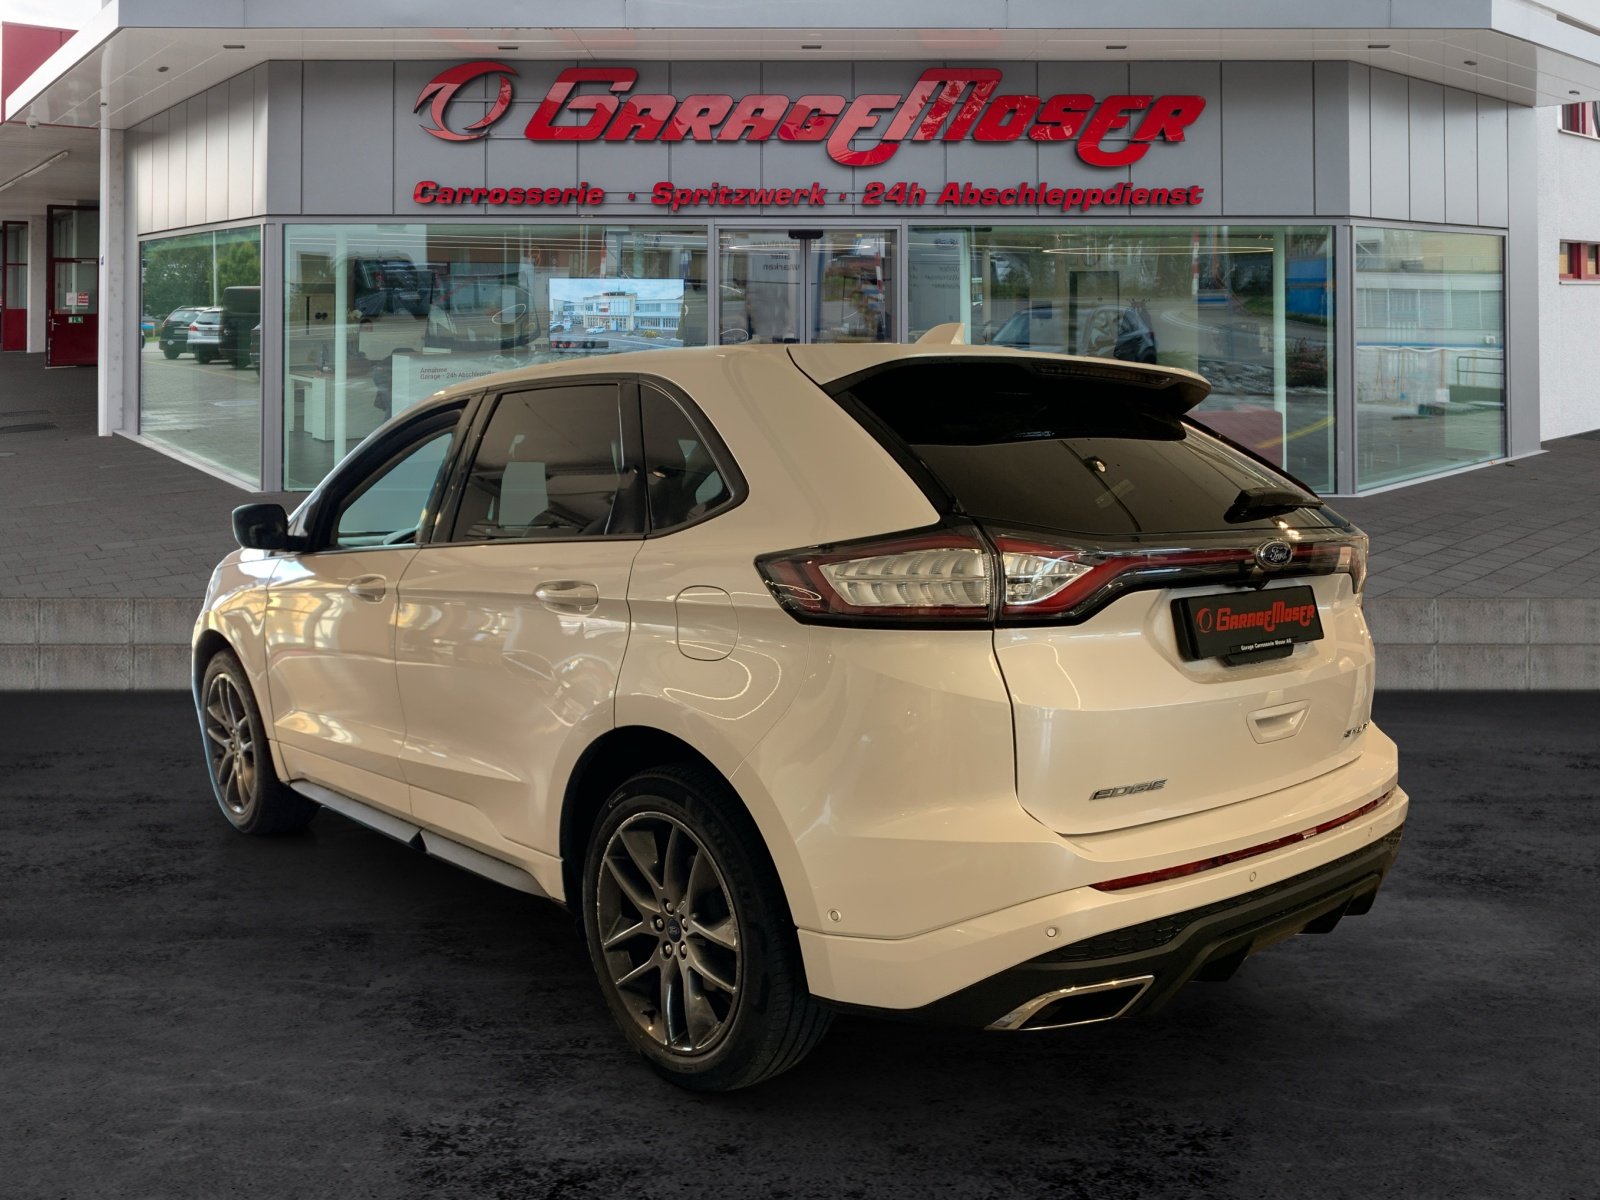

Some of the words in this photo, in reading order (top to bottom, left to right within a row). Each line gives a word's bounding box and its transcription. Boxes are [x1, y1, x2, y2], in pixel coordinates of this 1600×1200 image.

[413, 180, 606, 206] Carrosserie
[651, 181, 826, 213] Spritzwerk
[862, 181, 927, 207] 24h
[936, 181, 1204, 214] Abschleppdienst
[1089, 779, 1168, 801] EDGE
